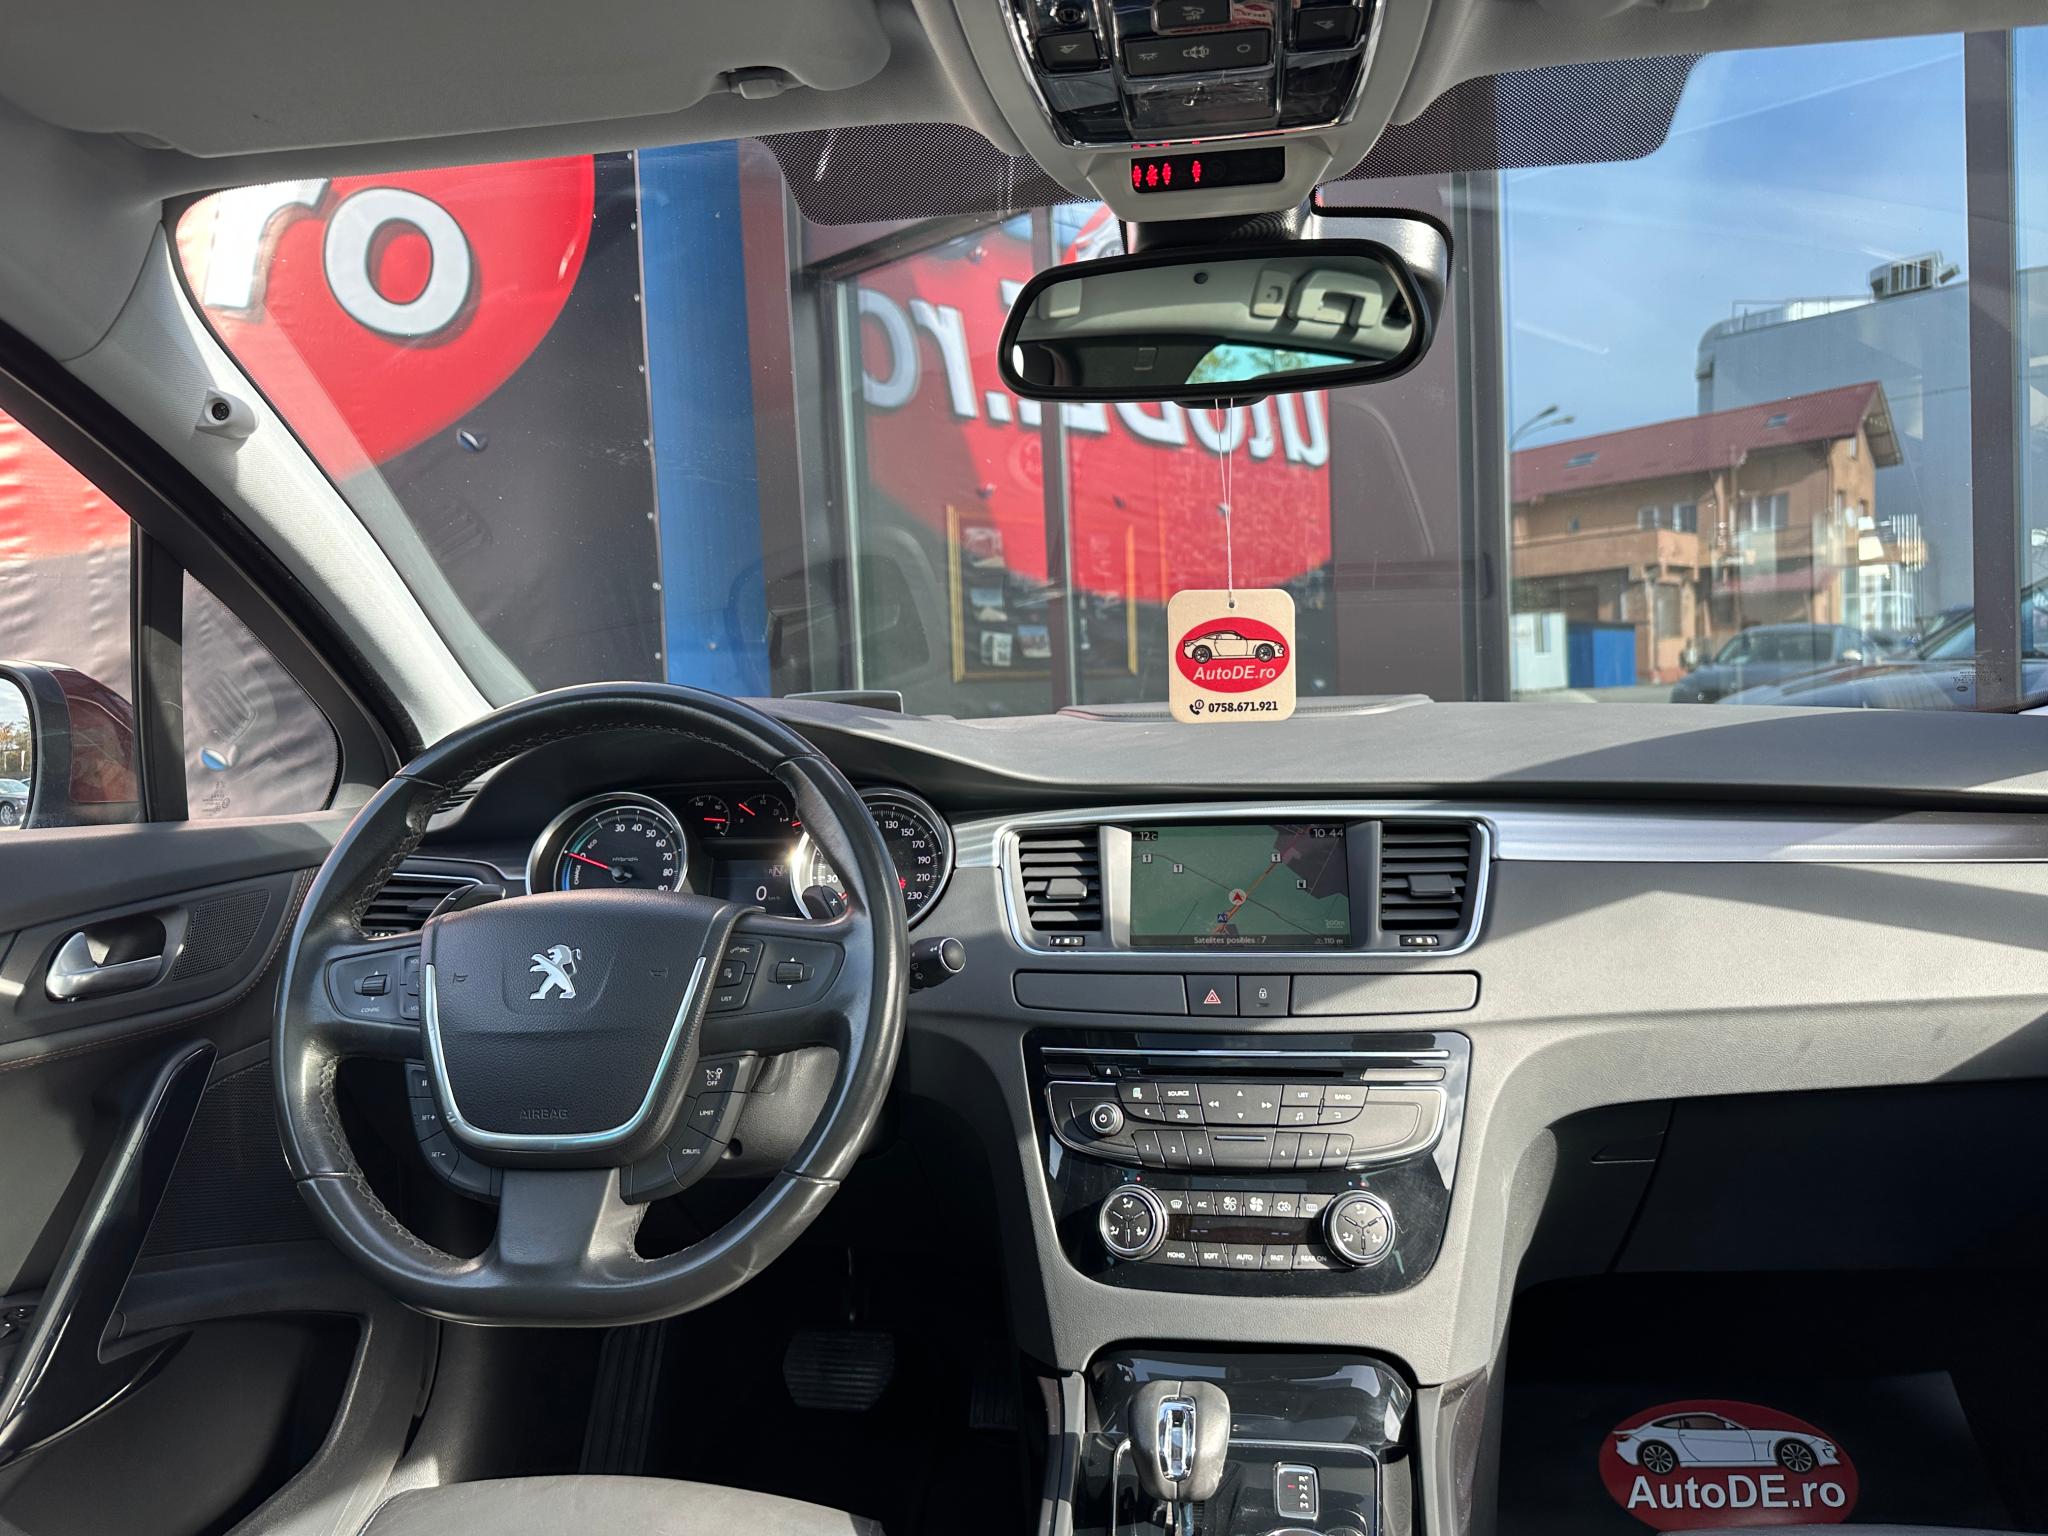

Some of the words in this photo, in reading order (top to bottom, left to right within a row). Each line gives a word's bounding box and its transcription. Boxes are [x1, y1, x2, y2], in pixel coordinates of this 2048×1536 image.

[1193, 665, 1276, 681] AutoDE.ro
[1208, 701, 1278, 713] 0758.671.921
[614, 824, 626, 832] 30
[631, 823, 642, 832] 40
[885, 820, 898, 829] 130
[646, 830, 656, 838] 50
[900, 828, 914, 836] 150
[656, 839, 666, 848] 60
[912, 840, 925, 848] 170
[662, 852, 673, 861] 70
[917, 856, 931, 864] 190
[662, 868, 674, 877] 80
[826, 874, 838, 884] 30
[916, 873, 930, 882] 210
[756, 886, 767, 900] 0
[907, 892, 922, 900] 230
[519, 1108, 569, 1120] AIRBAG
[1204, 1252, 1219, 1260] SOFT
[1270, 1254, 1284, 1262] FAST
[1627, 1474, 1846, 1510] AutoDE.ro
